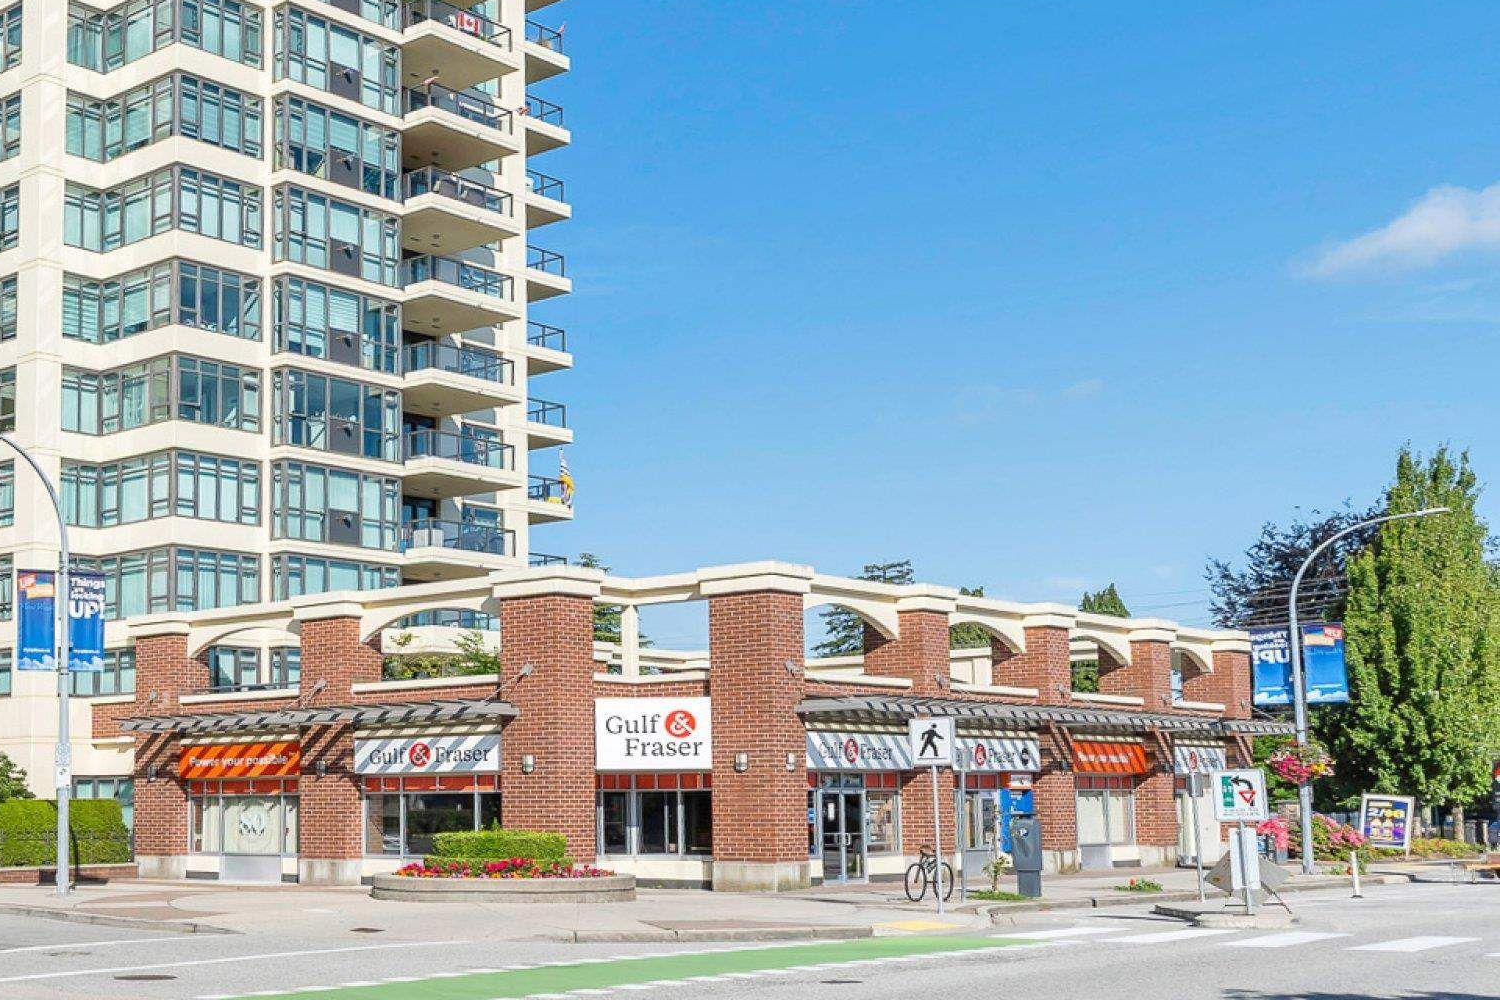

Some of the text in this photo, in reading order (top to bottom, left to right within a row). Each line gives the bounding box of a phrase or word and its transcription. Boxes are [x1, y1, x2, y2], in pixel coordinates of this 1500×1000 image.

[70, 577, 105, 589] Things
[69, 600, 104, 618] UP!
[605, 711, 695, 736] Gulf &
[369, 743, 491, 766] Gulf & Fraser
[625, 738, 703, 757] Fraser
[860, 744, 893, 760] Fraser
[190, 756, 219, 767] Power
[220, 756, 244, 768] your
